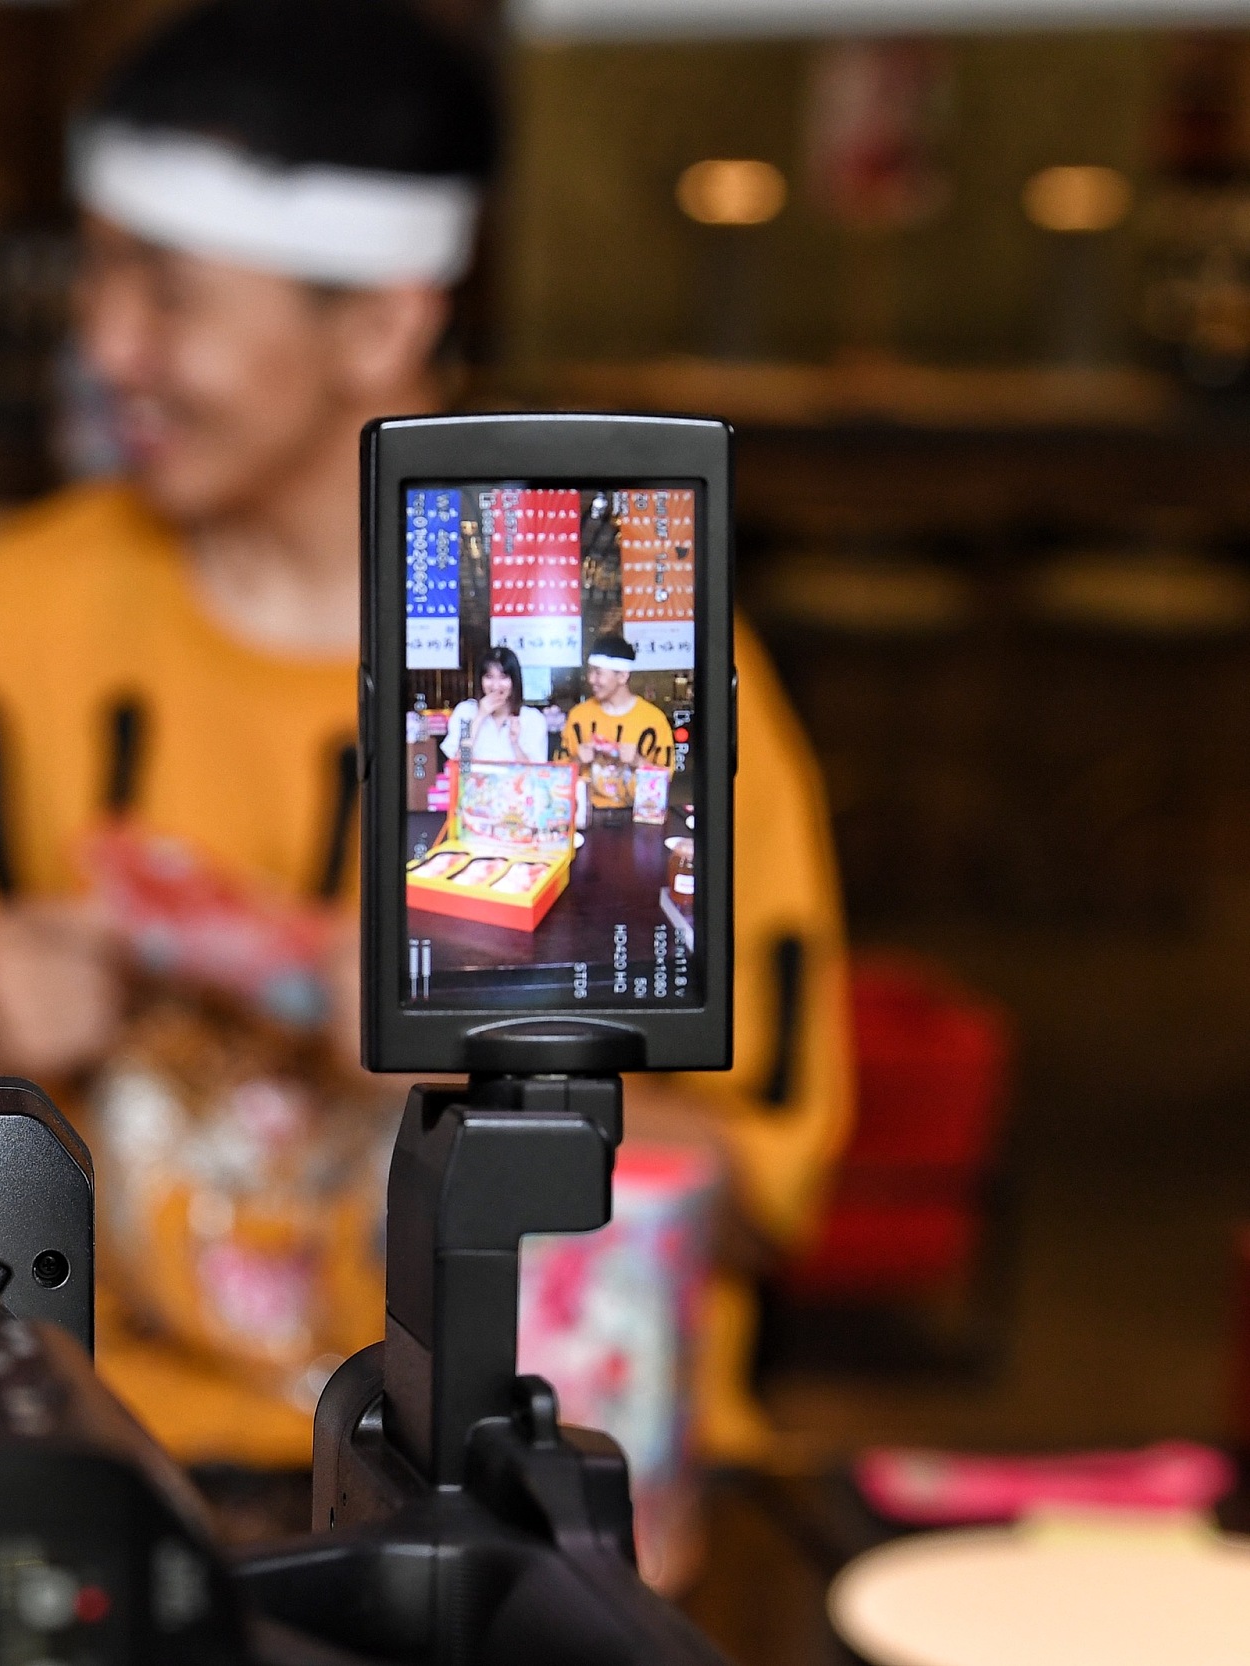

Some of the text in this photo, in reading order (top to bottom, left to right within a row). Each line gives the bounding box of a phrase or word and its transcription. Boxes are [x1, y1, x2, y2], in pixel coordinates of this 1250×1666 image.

[674, 743, 689, 772] Rec
[613, 923, 627, 993] HD420 HQ
